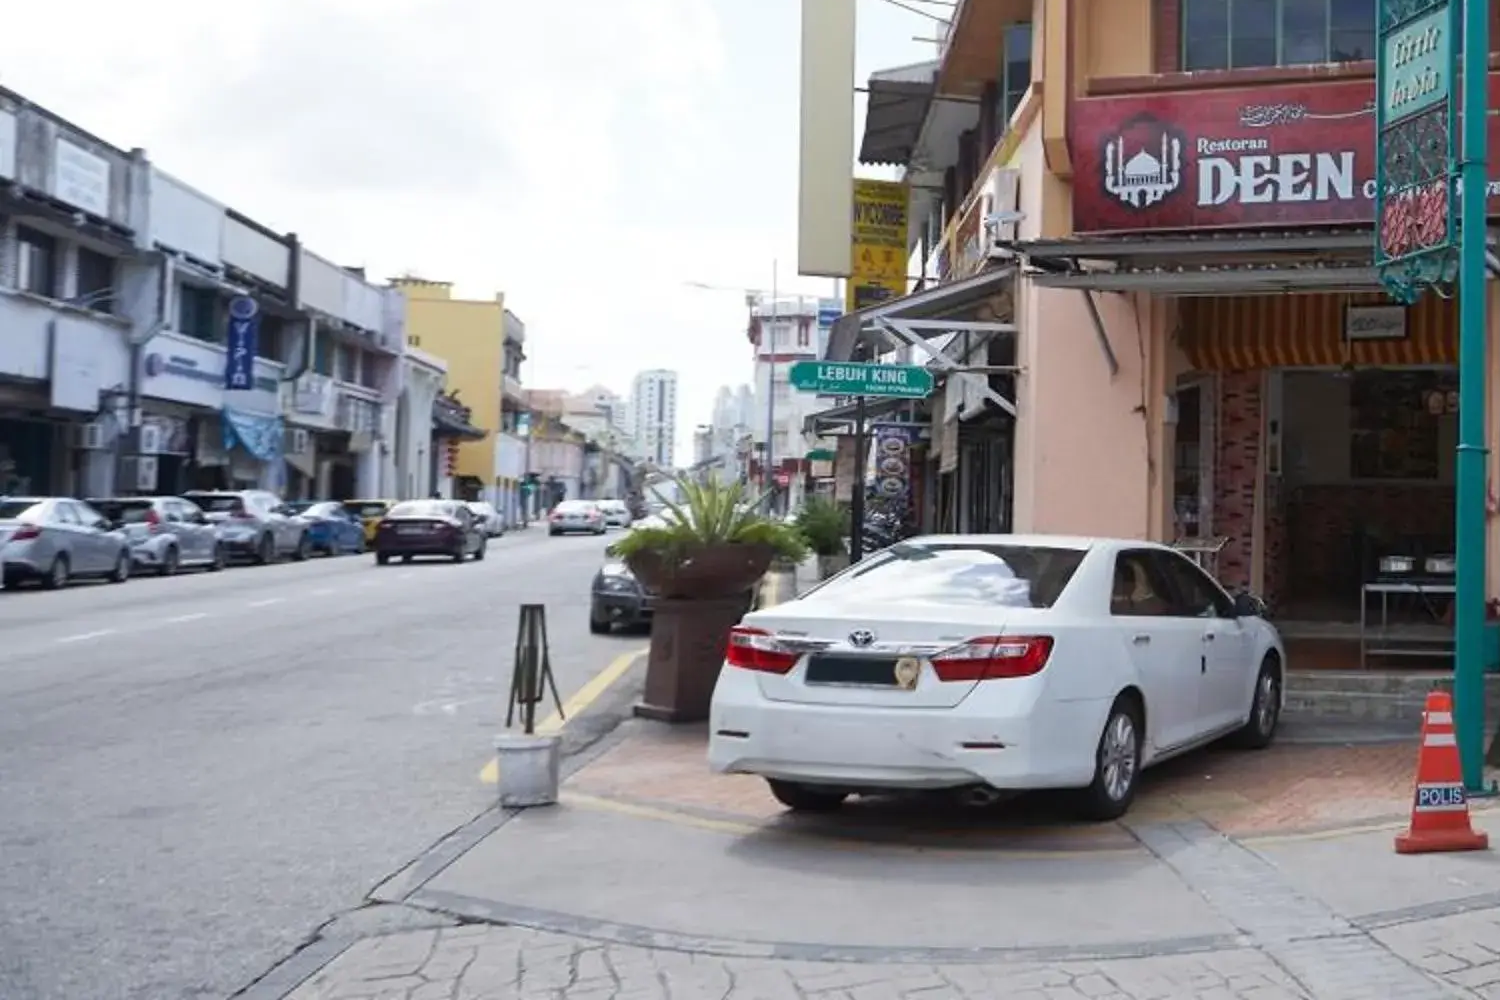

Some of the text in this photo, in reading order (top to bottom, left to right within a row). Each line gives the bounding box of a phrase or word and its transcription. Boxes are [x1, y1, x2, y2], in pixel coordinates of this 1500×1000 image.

[1197, 137, 1268, 153] Restoran
[1197, 152, 1355, 206] DEEN
[817, 365, 908, 384] LEBUH KING
[1419, 786, 1463, 806] POLIS
